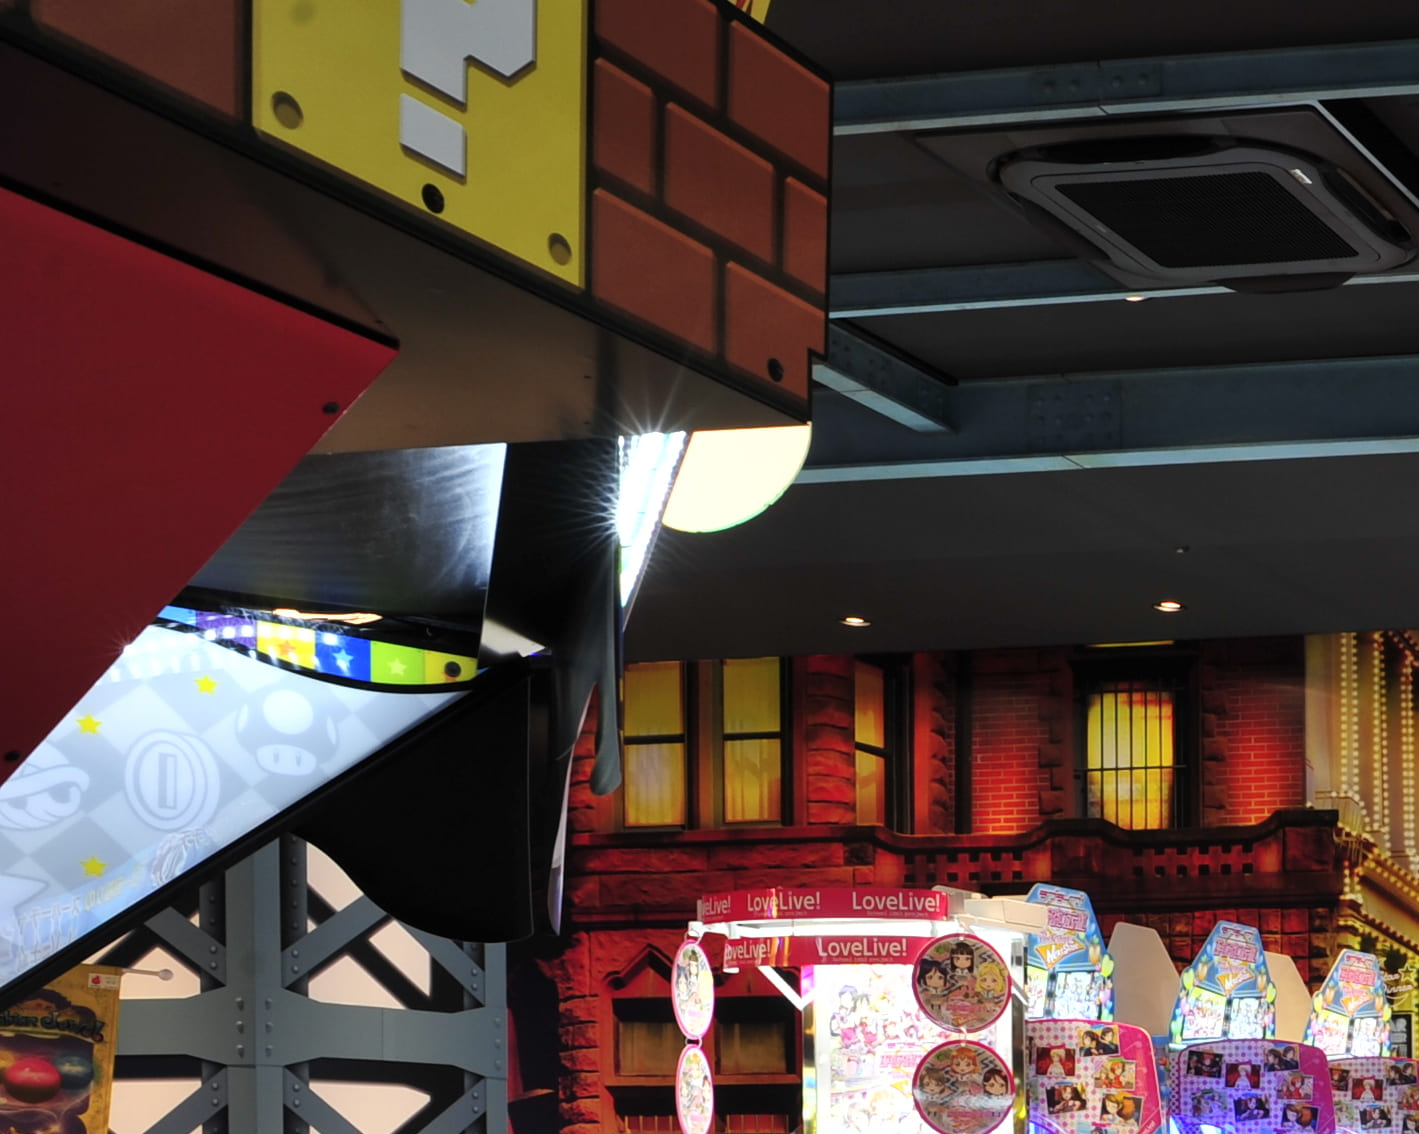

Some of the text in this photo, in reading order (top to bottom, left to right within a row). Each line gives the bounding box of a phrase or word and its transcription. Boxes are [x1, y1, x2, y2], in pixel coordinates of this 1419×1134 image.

[747, 892, 821, 912] LoveLive!
[851, 890, 941, 912] LoveLive!
[818, 938, 907, 957] LoveLive!
